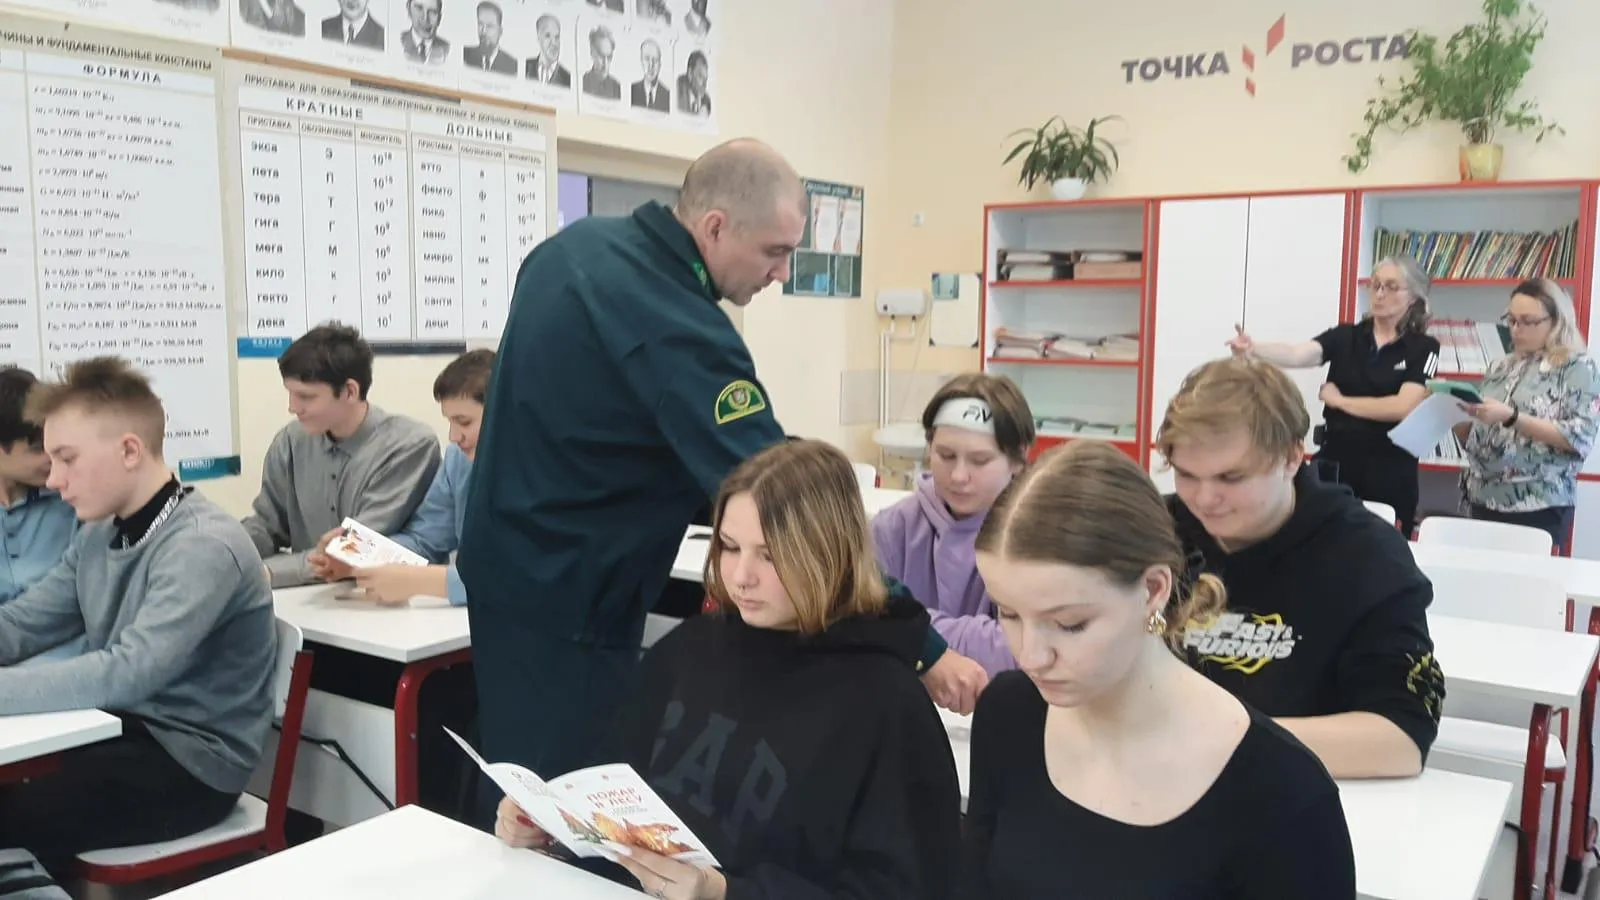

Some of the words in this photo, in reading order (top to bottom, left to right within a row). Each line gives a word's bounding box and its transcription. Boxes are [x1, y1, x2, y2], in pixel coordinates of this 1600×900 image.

[36, 35, 44, 46] И
[47, 38, 152, 61] ФУНДАМЕНТАЛЬНЫЕ
[154, 53, 213, 71] КОНСТАНТЫ
[1121, 51, 1230, 83] ТОЧКА
[1291, 34, 1411, 68] РОСТА
[83, 63, 162, 84] ФОРМУЛА
[244, 73, 295, 91] ПРИСТАВКИ
[300, 83, 317, 95] ДЛЯ
[320, 87, 379, 104] ОБРАЗОВАНИЯ
[286, 97, 364, 120] КРАТНЫЕ
[247, 115, 292, 129] ПРИСТАВКА
[446, 122, 513, 143] ДОЛЬНЫЕ
[254, 217, 279, 229] гига
[255, 242, 283, 254] мега
[328, 244, 338, 257] М
[256, 268, 285, 279] кило
[257, 292, 288, 304] гекто
[256, 317, 285, 329] дека
[1183, 630, 1296, 660] FURIOUS
[586, 786, 636, 802] ПОЖАР
[609, 794, 642, 808] ЛЕСУ
